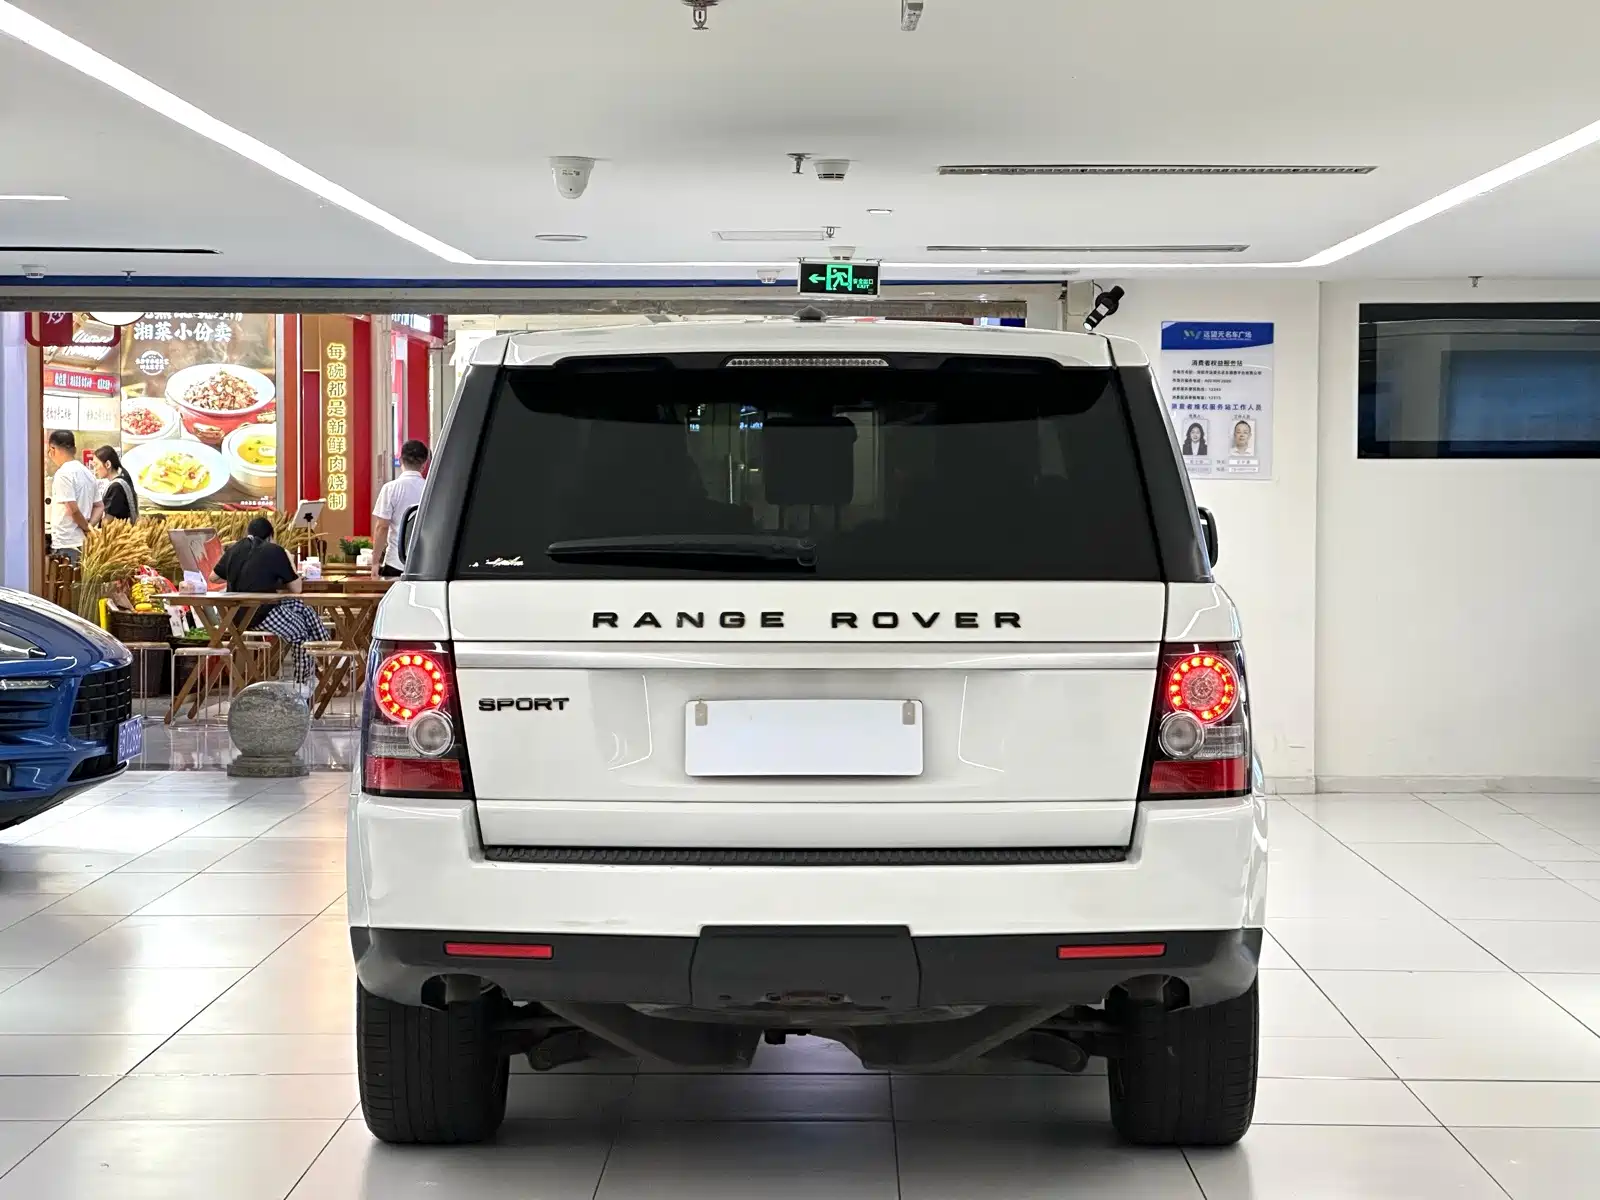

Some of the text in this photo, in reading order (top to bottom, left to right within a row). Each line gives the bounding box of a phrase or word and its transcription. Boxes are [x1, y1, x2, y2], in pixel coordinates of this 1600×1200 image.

[133, 321, 233, 342] 湘菜小份卖
[326, 343, 347, 511] 每碗都是新鲜肉烧制
[593, 612, 1021, 628] RANGE ROVER
[479, 698, 569, 711] SPORT
